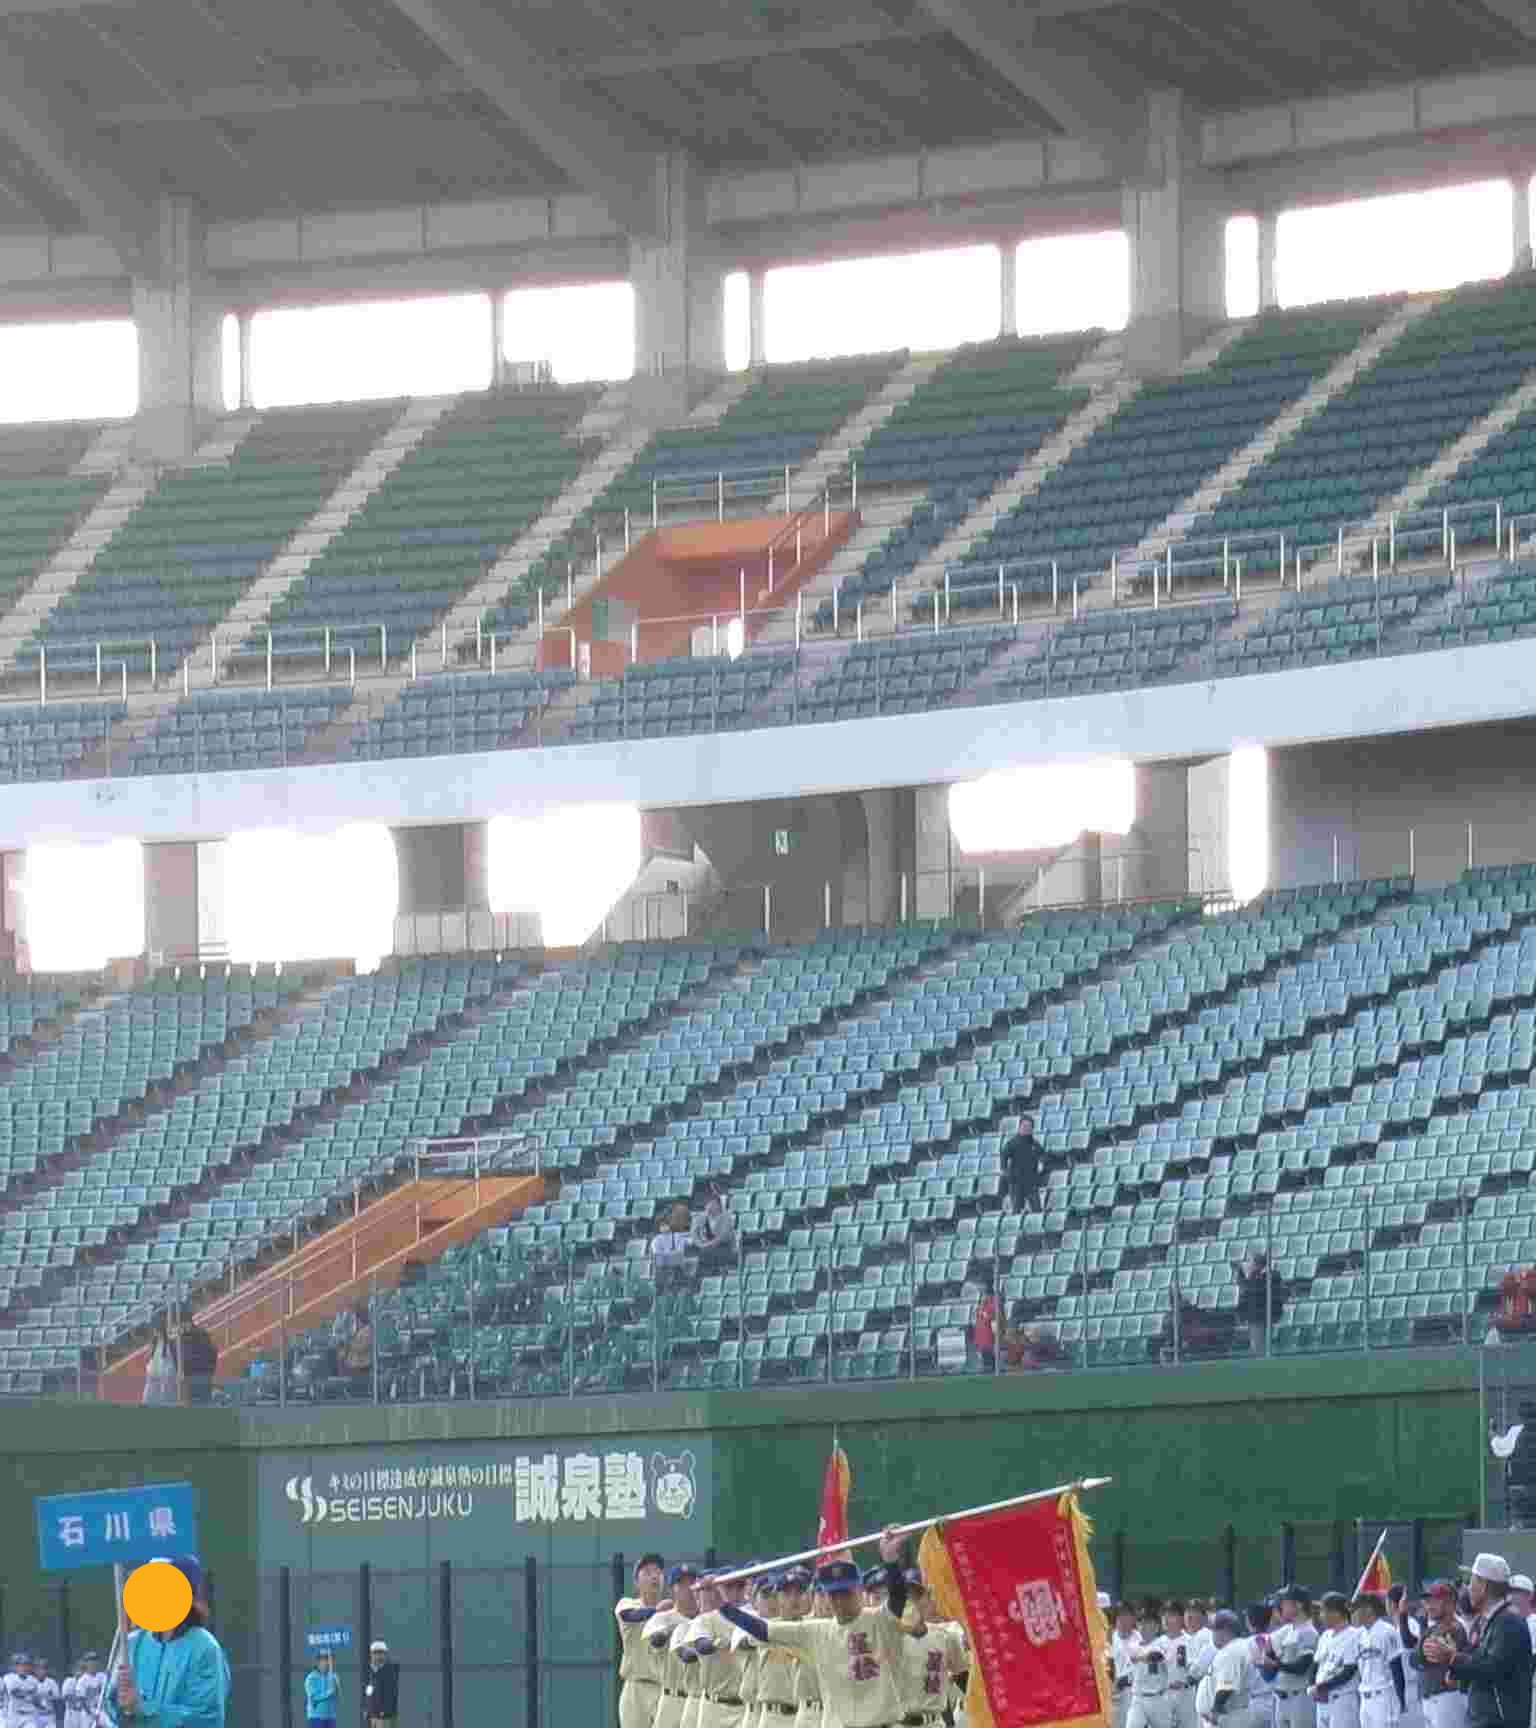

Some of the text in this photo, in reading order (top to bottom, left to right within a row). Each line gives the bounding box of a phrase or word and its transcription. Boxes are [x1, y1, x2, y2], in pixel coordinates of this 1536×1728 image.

[515, 1452, 646, 1521] 誠泉塾
[58, 1507, 177, 1547] 石川県
[329, 1492, 472, 1522] SEISENJUKU
